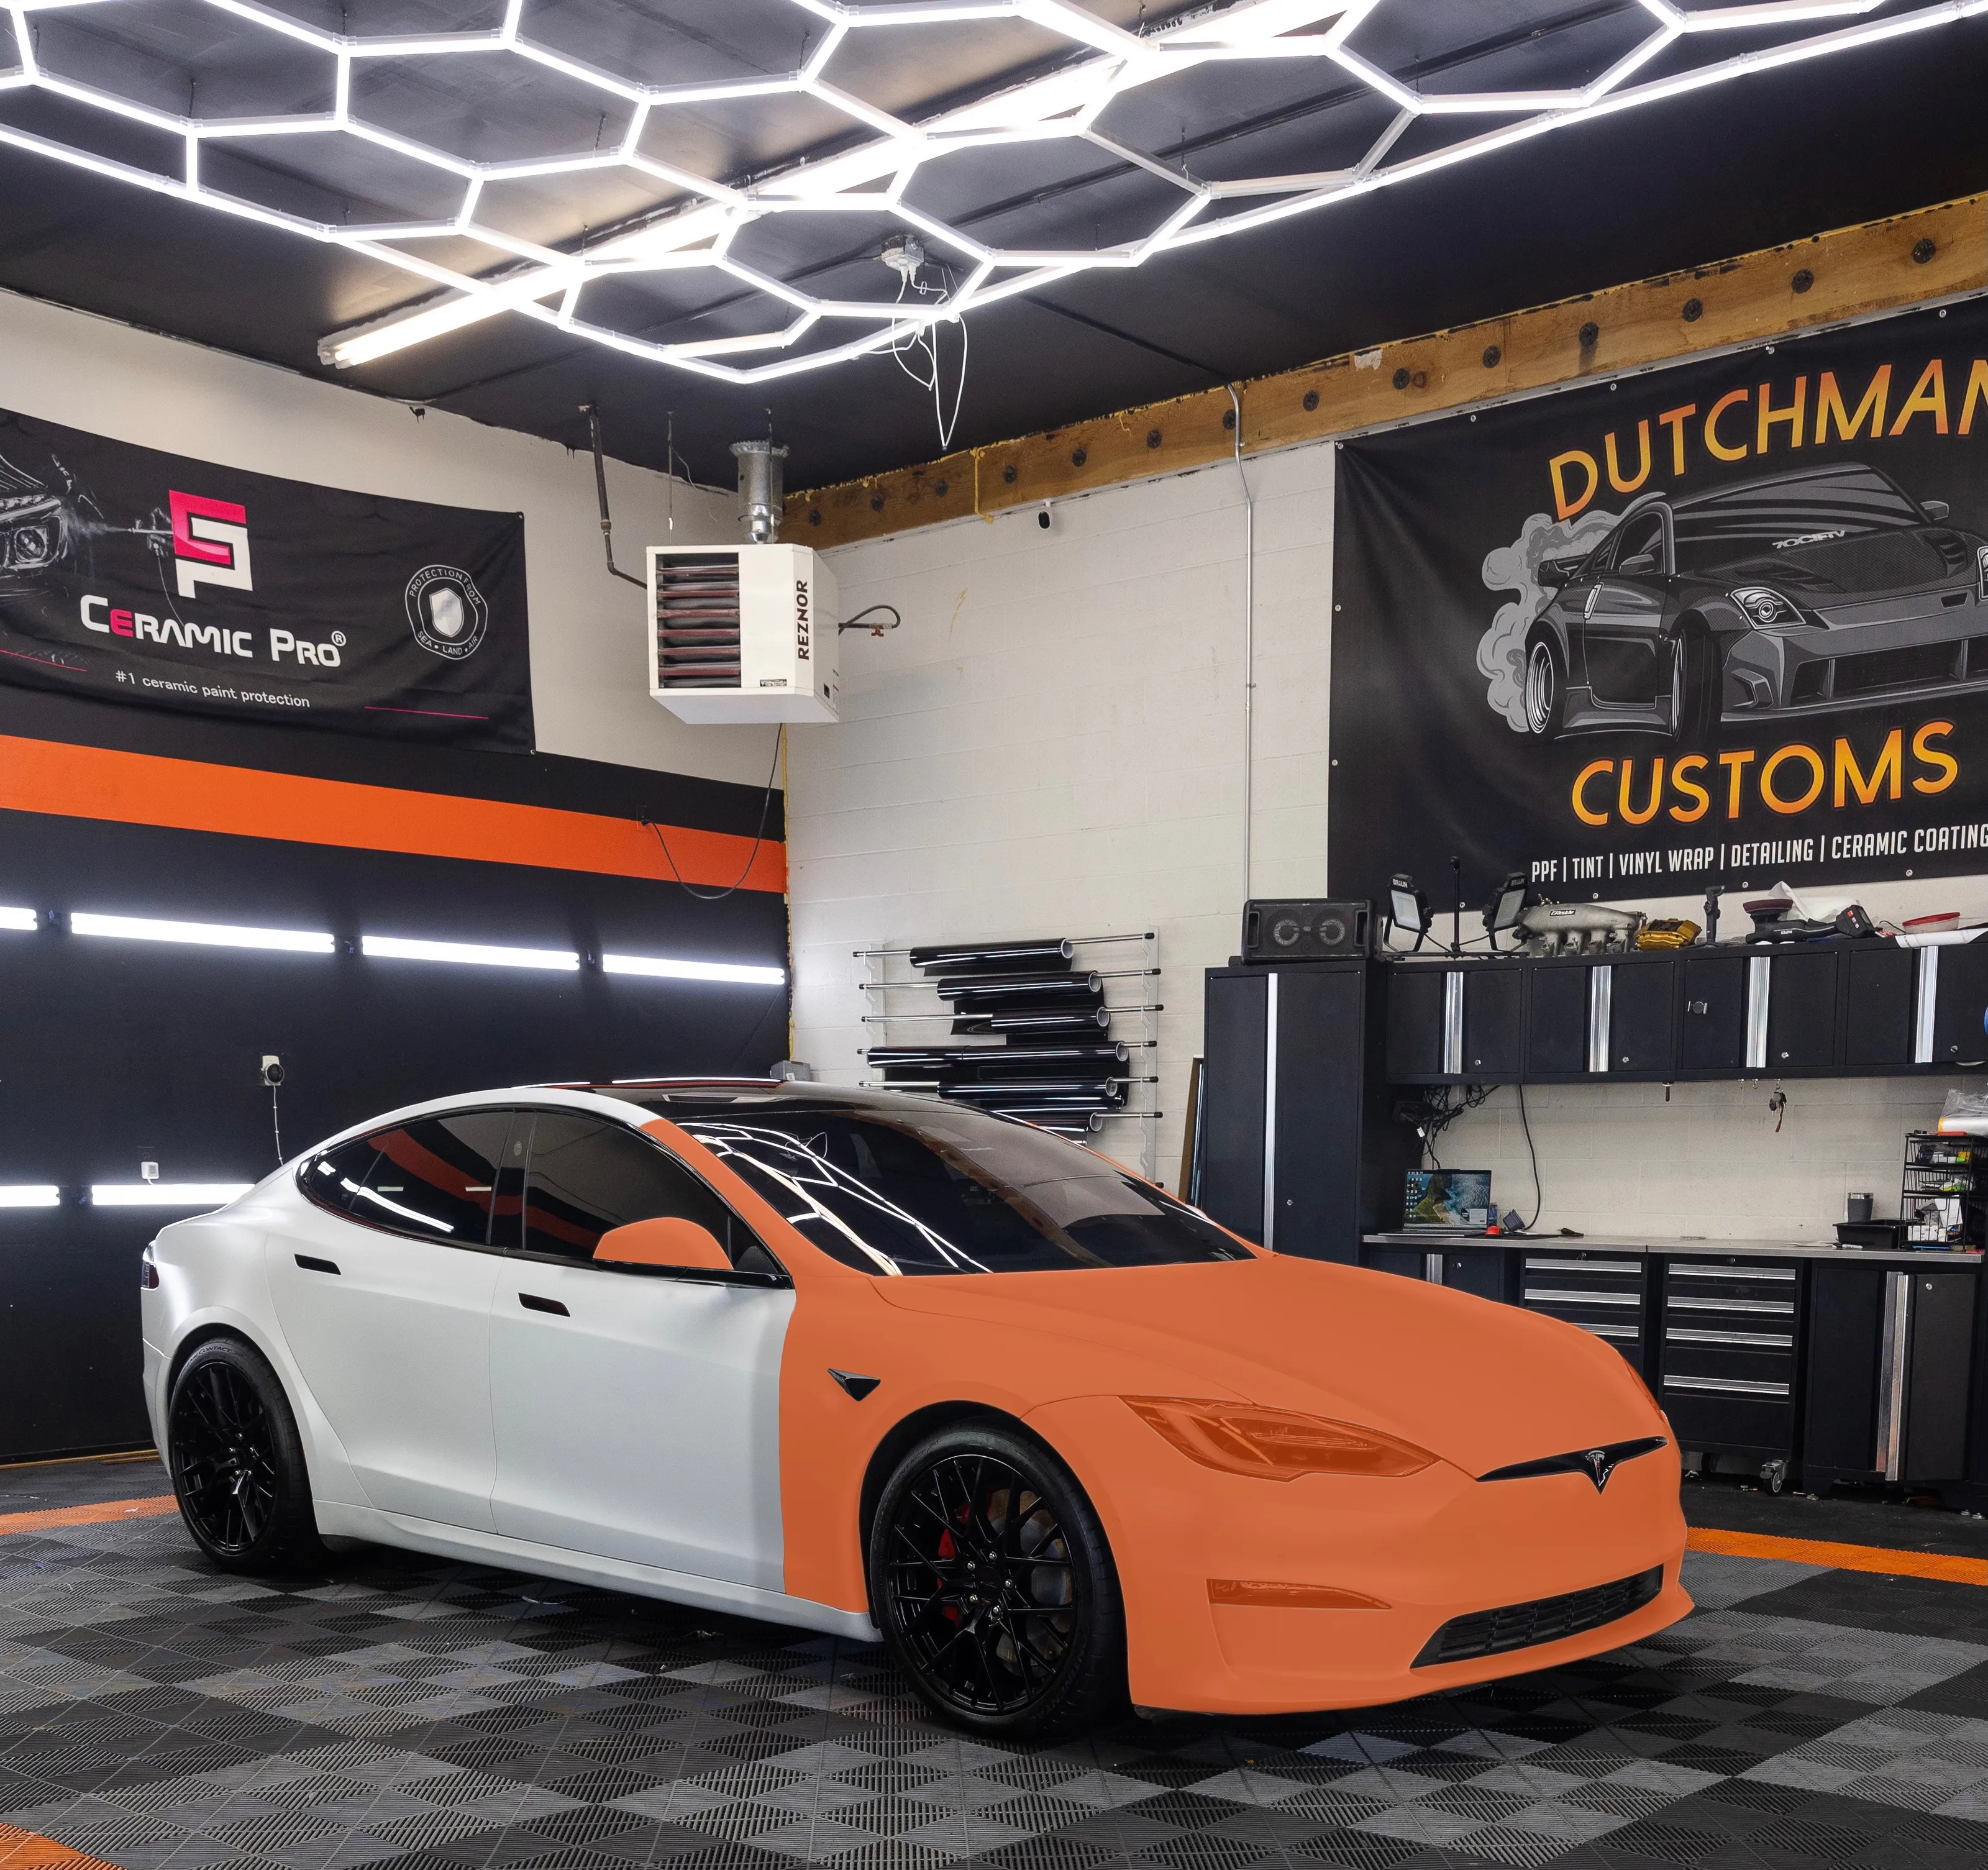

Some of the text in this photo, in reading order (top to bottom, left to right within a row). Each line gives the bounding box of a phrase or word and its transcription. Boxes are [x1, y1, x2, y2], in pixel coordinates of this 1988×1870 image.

[409, 568, 481, 605] PROTECTION FROM
[796, 580, 809, 660] REZNOR
[417, 631, 478, 655] SEA LAND AIR
[116, 670, 310, 708] #1 ceramic paint protection
[1571, 721, 1959, 826] CUSTOMS
[1531, 860, 1557, 882] PPF
[1572, 856, 1603, 879] TINT
[1619, 851, 1662, 876] VINYL
[1668, 847, 1714, 872] WRAP
[1731, 839, 1813, 867] DETAILING
[1831, 831, 1908, 859] CERAMIC
[1392, 878, 1408, 888] BRAUN
